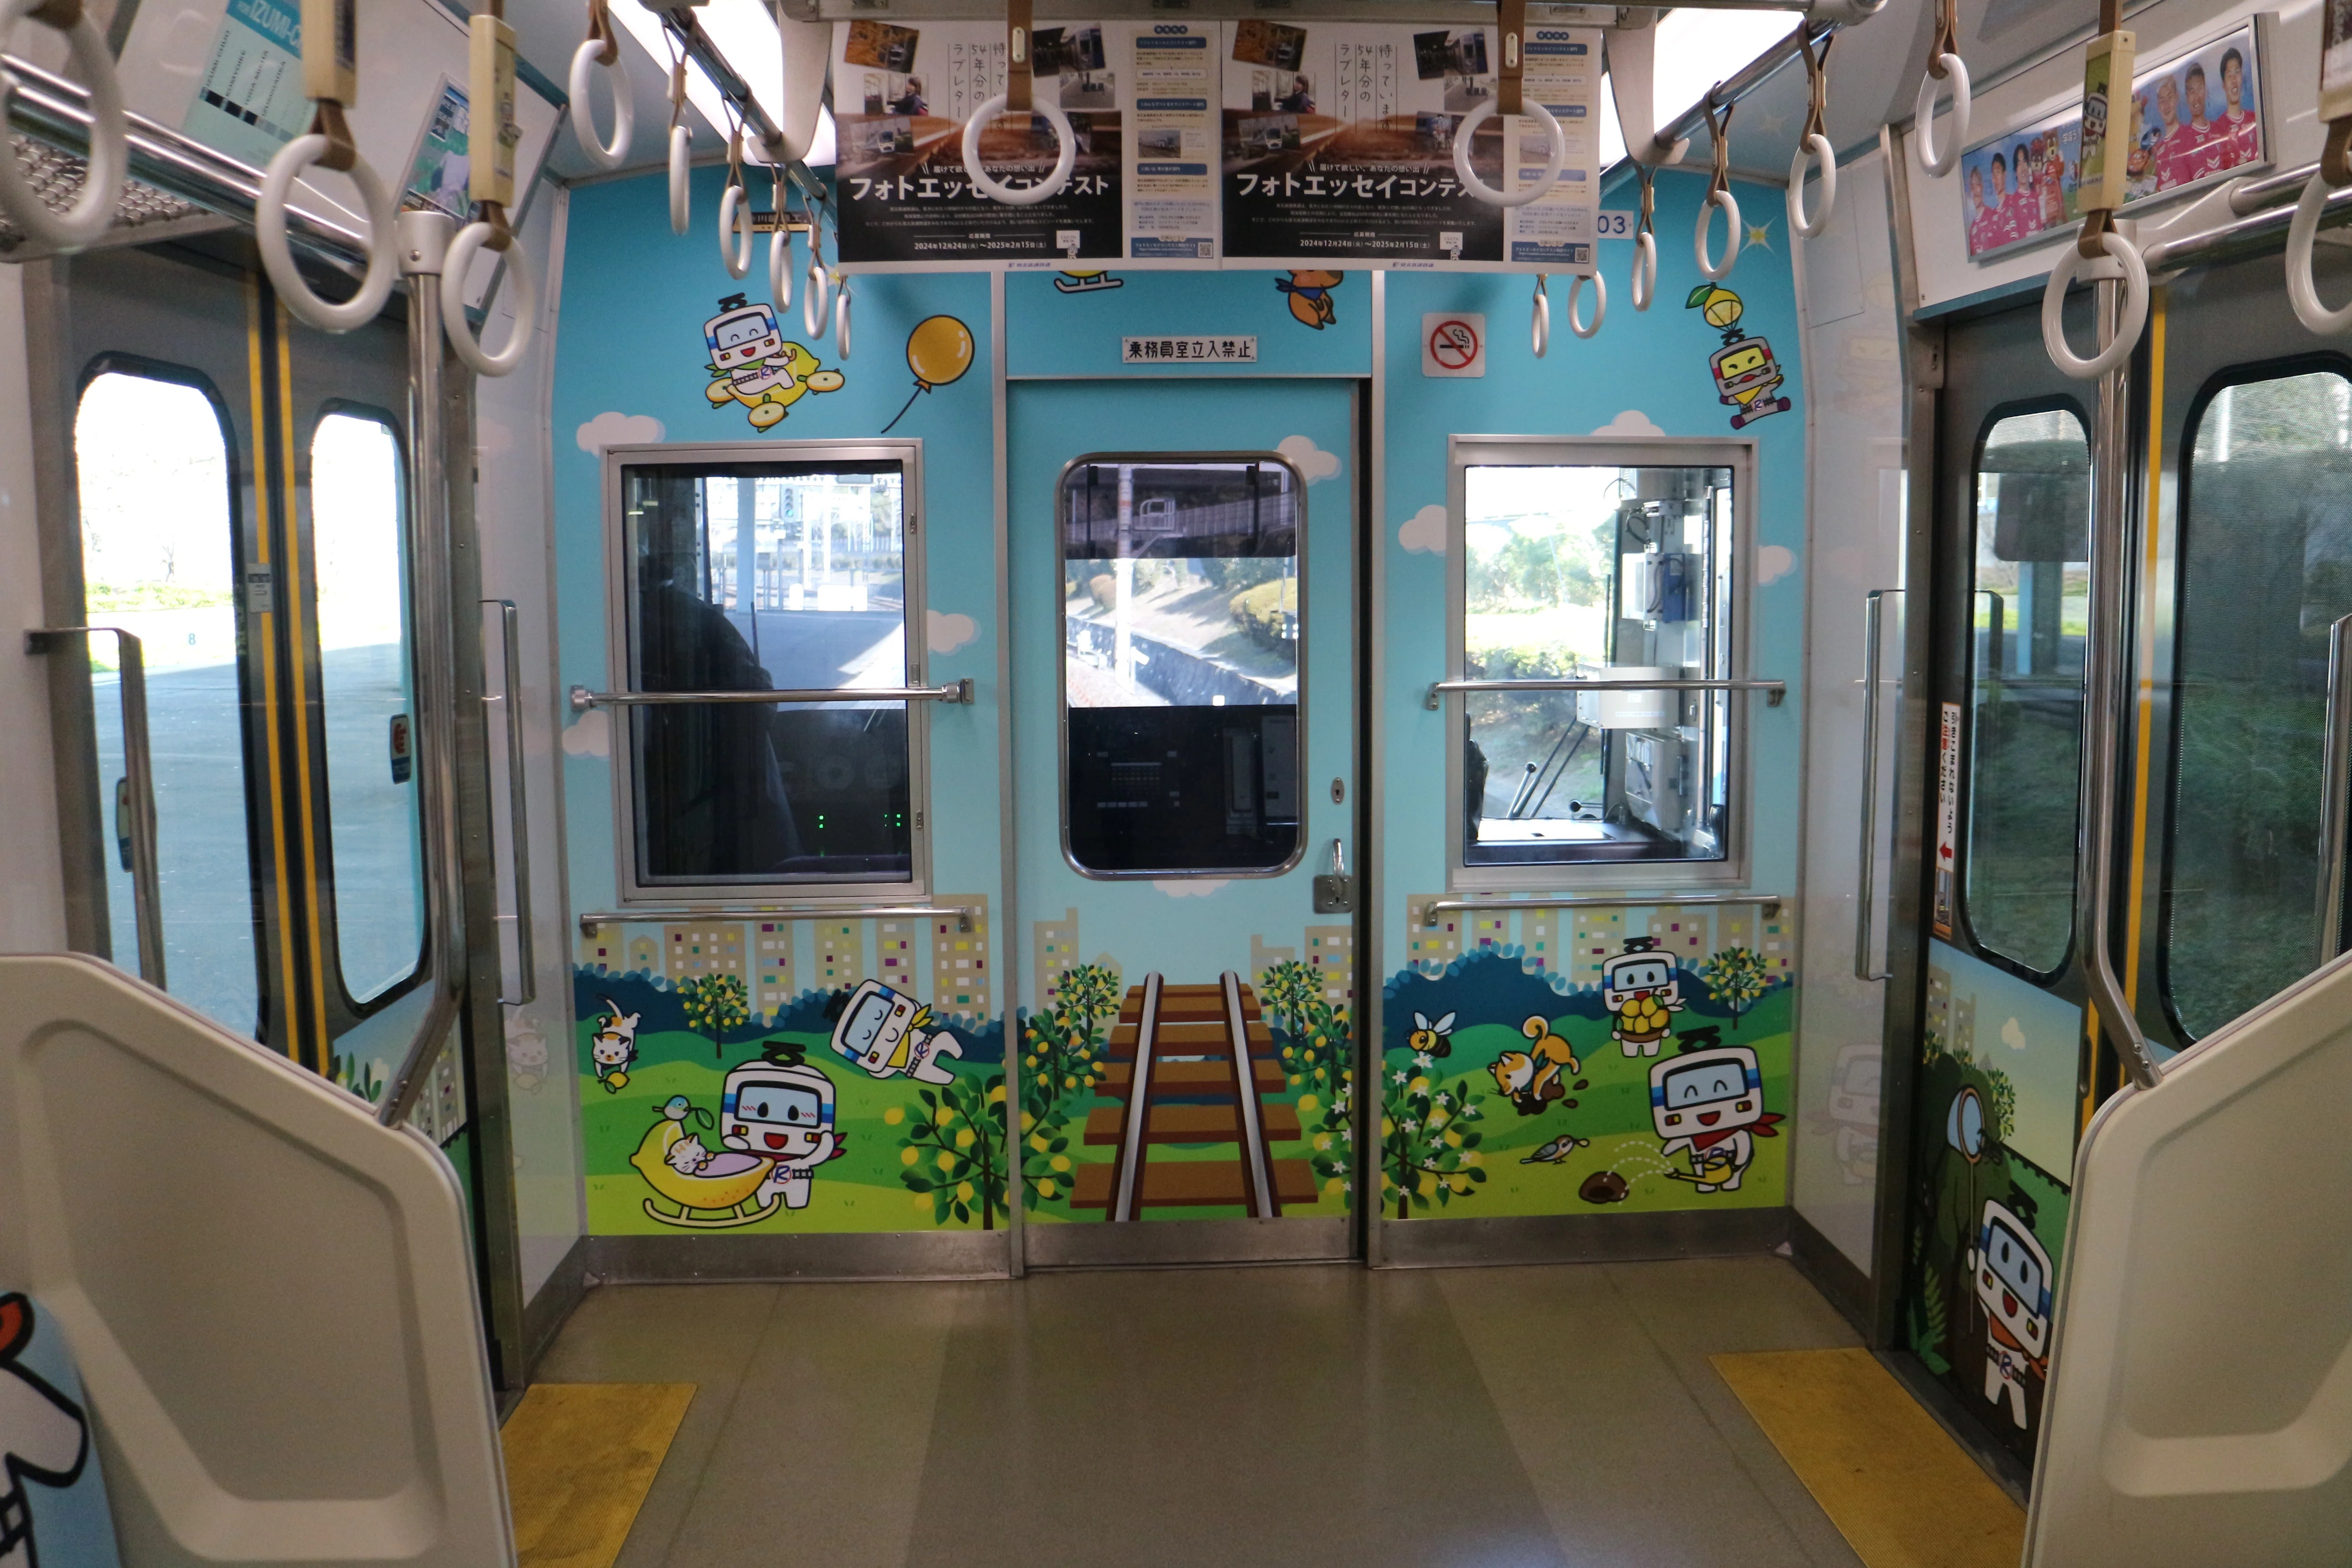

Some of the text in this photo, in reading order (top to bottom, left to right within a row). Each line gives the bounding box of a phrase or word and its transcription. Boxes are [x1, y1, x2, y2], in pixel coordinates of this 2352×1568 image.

[953, 44, 966, 118] ラブレター
[972, 44, 988, 101] 54年分の
[1339, 44, 1352, 118] ラブレター
[1358, 44, 1373, 102] 54年分の
[1377, 44, 1393, 132] 待っています
[1320, 163, 1420, 173] 届けて欲しい、あなたの想い出
[1129, 341, 1250, 358] 乗務員室立入禁止
